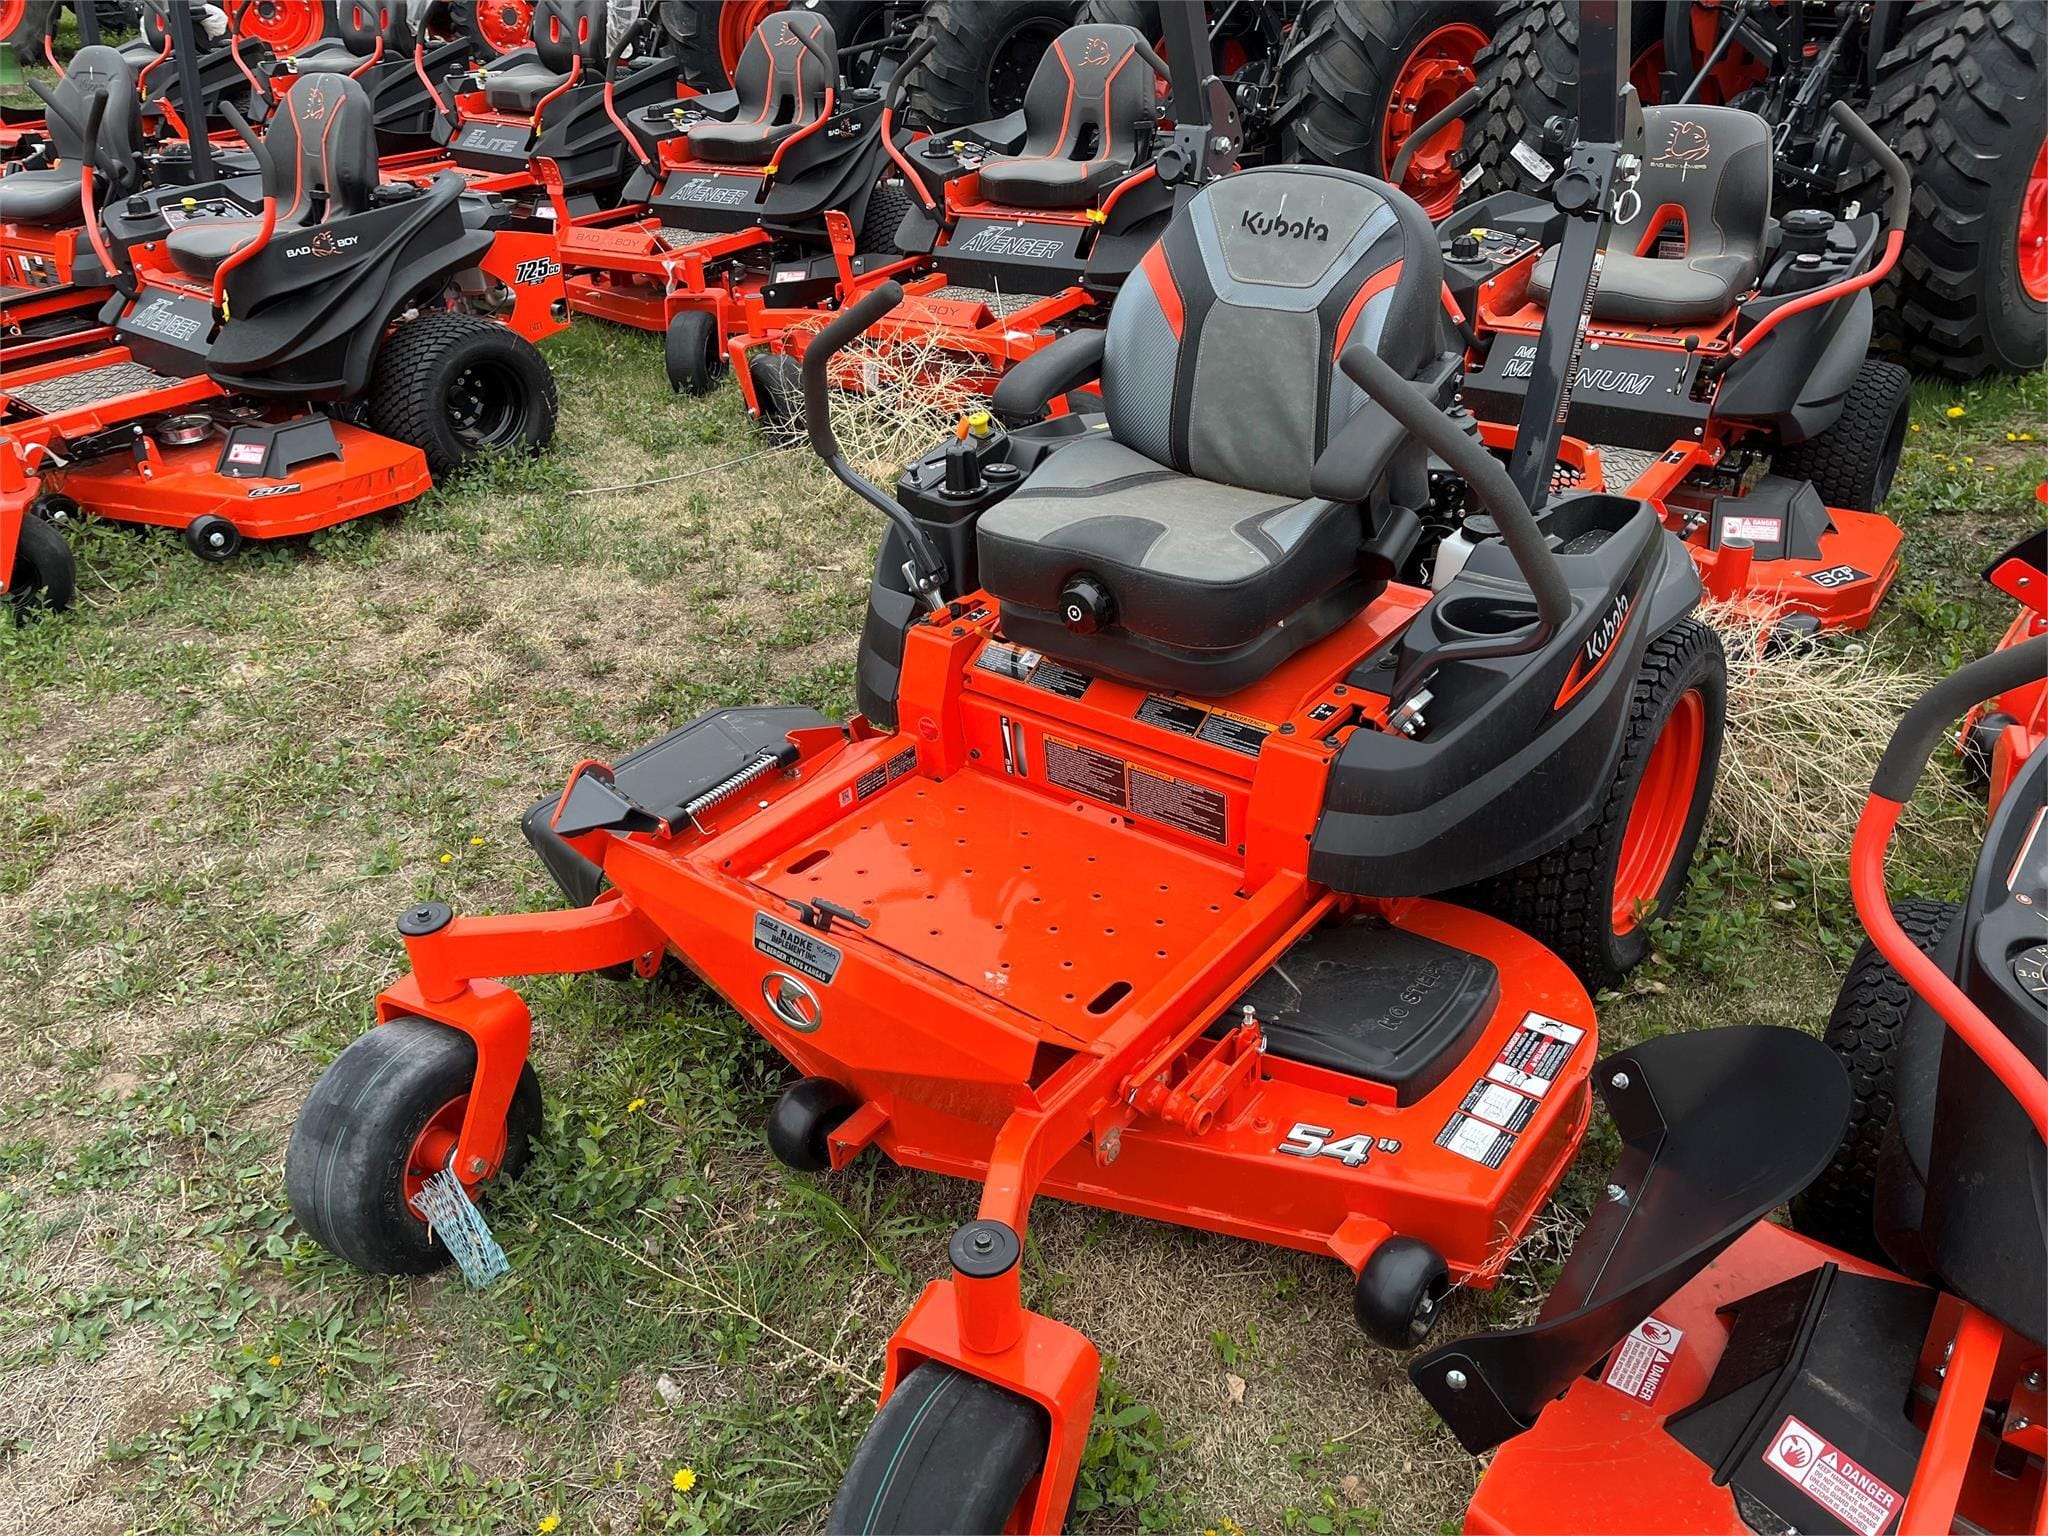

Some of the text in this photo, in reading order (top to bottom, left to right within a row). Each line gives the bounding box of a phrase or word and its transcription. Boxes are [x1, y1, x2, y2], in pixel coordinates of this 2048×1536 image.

[462, 136, 519, 152] ELITE
[670, 183, 749, 205] AVENGER
[576, 233, 640, 247] BAD BOY
[1241, 210, 1329, 241] Kubota
[286, 236, 358, 258] BAD BOY
[960, 233, 1064, 259] AVENGER
[131, 307, 202, 341] AVENGER
[1586, 594, 1629, 661] Kubota
[1228, 713, 1268, 728] ADVERTENCIA
[771, 934, 819, 964] IMPLEMENT INC.
[780, 928, 813, 951] RADKE
[803, 964, 826, 980] KANSAS
[1377, 965, 1441, 1031] NO STEP
[1278, 1122, 1402, 1168] 54"
[1639, 1364, 1664, 1400] DANGER
[1808, 1483, 1833, 1504] CATCHER
[1833, 1501, 1840, 1509] IS
[1814, 1469, 1880, 1521] DO NOT OPERATE MOWER
[1816, 1462, 1831, 1475] KEEP
[1830, 1472, 1849, 1489] HANDS
[1854, 1490, 1868, 1502] FEET
[1840, 1462, 1895, 1507] DANGER
[1808, 1474, 1877, 1528] UNLESS GUARD OR GRASS
